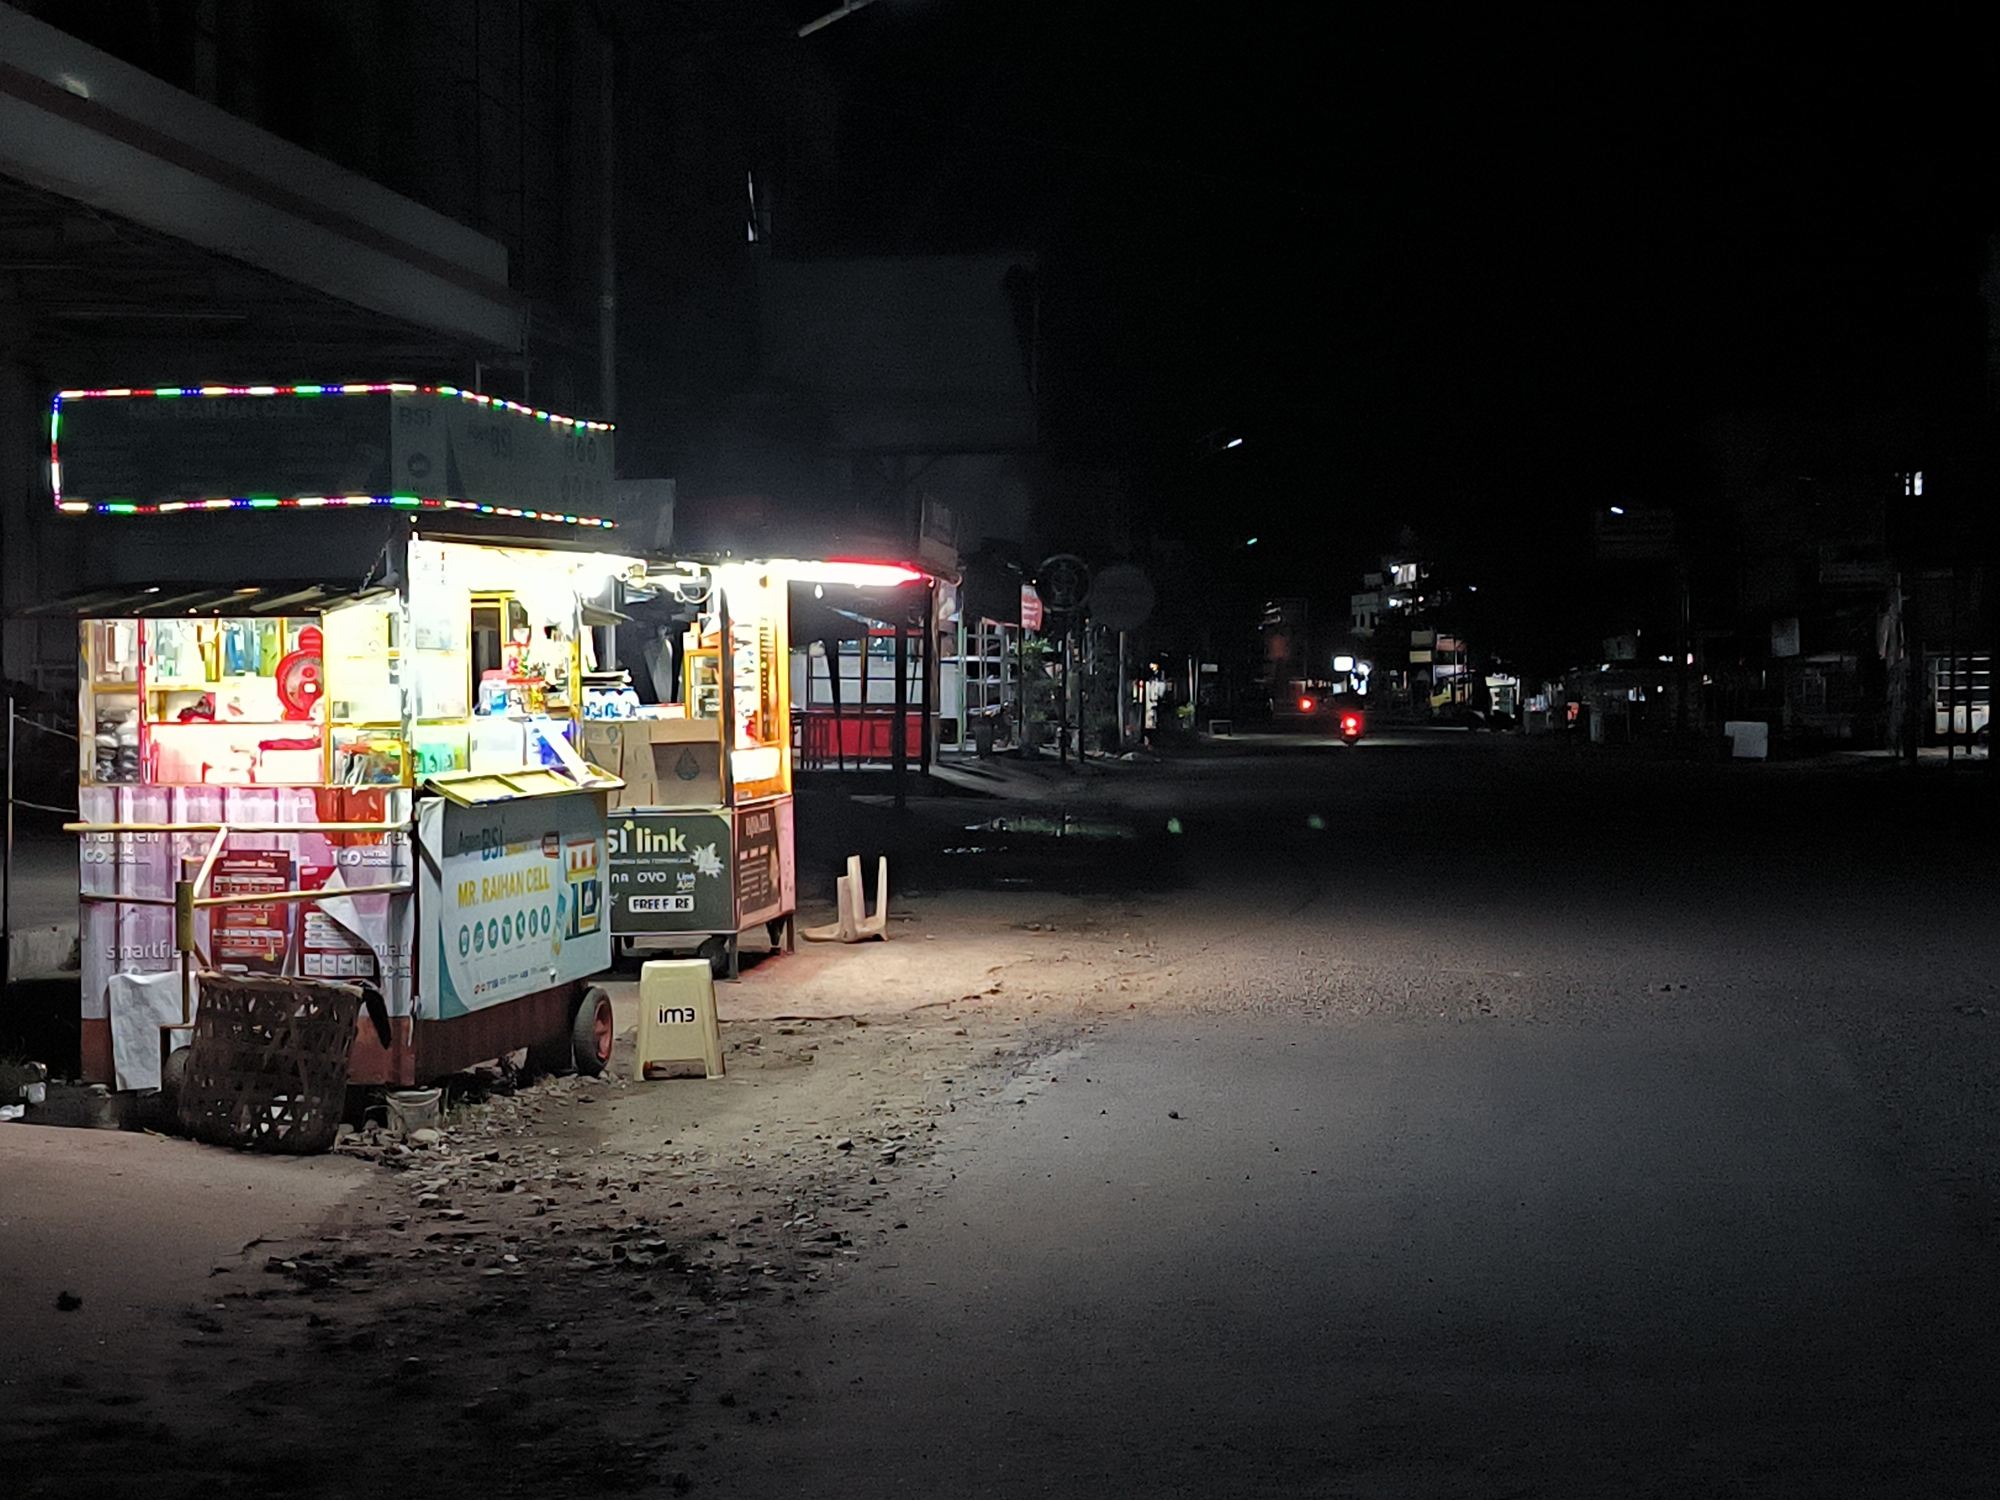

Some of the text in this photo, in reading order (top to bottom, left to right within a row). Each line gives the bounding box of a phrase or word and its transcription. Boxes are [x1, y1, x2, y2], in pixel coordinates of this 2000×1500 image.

[607, 827, 687, 854] SI link
[458, 865, 551, 910] MR. RAIHAN CELL
[633, 898, 660, 910] FREE
